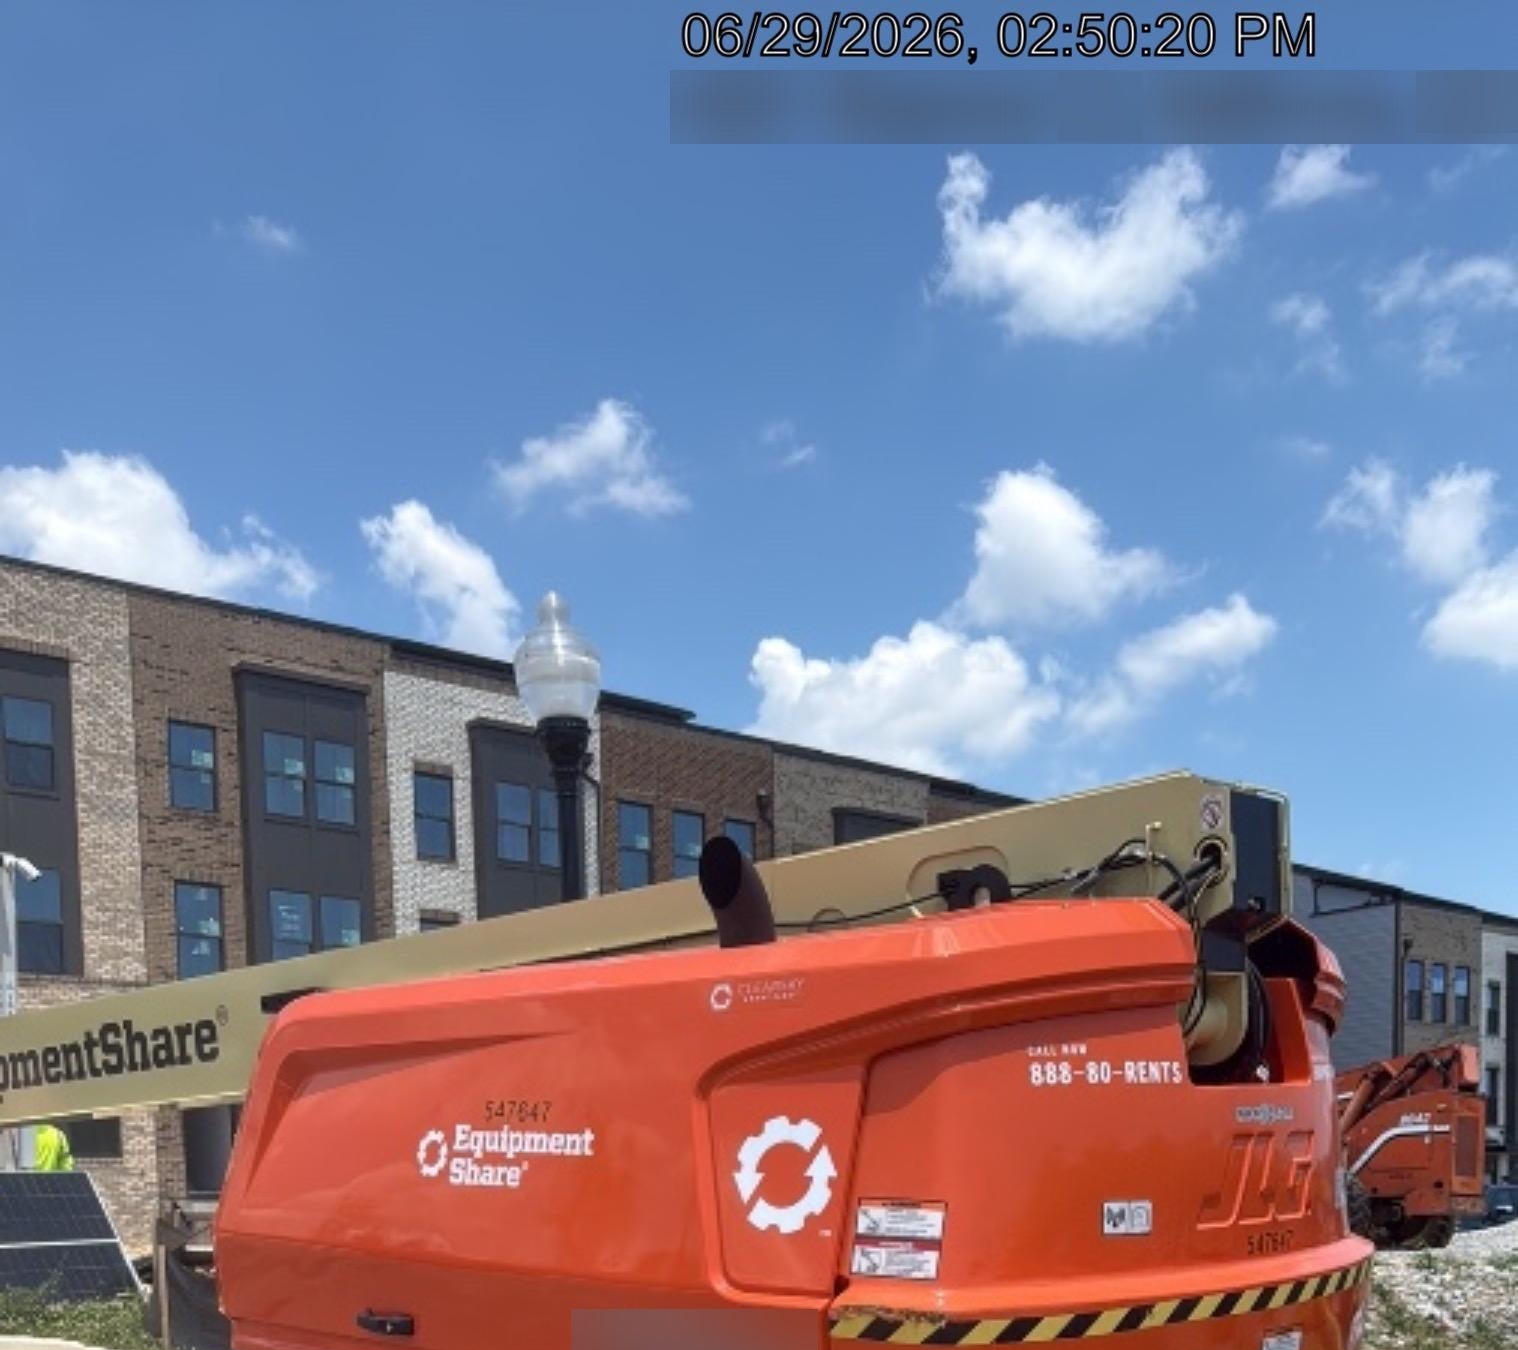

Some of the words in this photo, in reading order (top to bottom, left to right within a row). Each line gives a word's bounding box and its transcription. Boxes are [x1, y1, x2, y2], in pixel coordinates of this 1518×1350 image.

[1028, 1045, 1057, 1057] CALL
[1061, 1043, 1087, 1056] NOW
[1029, 1060, 1183, 1087] 888-80-RENTS
[485, 1100, 552, 1123] 547647
[453, 1124, 595, 1159] Equipment
[450, 1157, 521, 1188] Share
[1196, 1129, 1315, 1231] JLG
